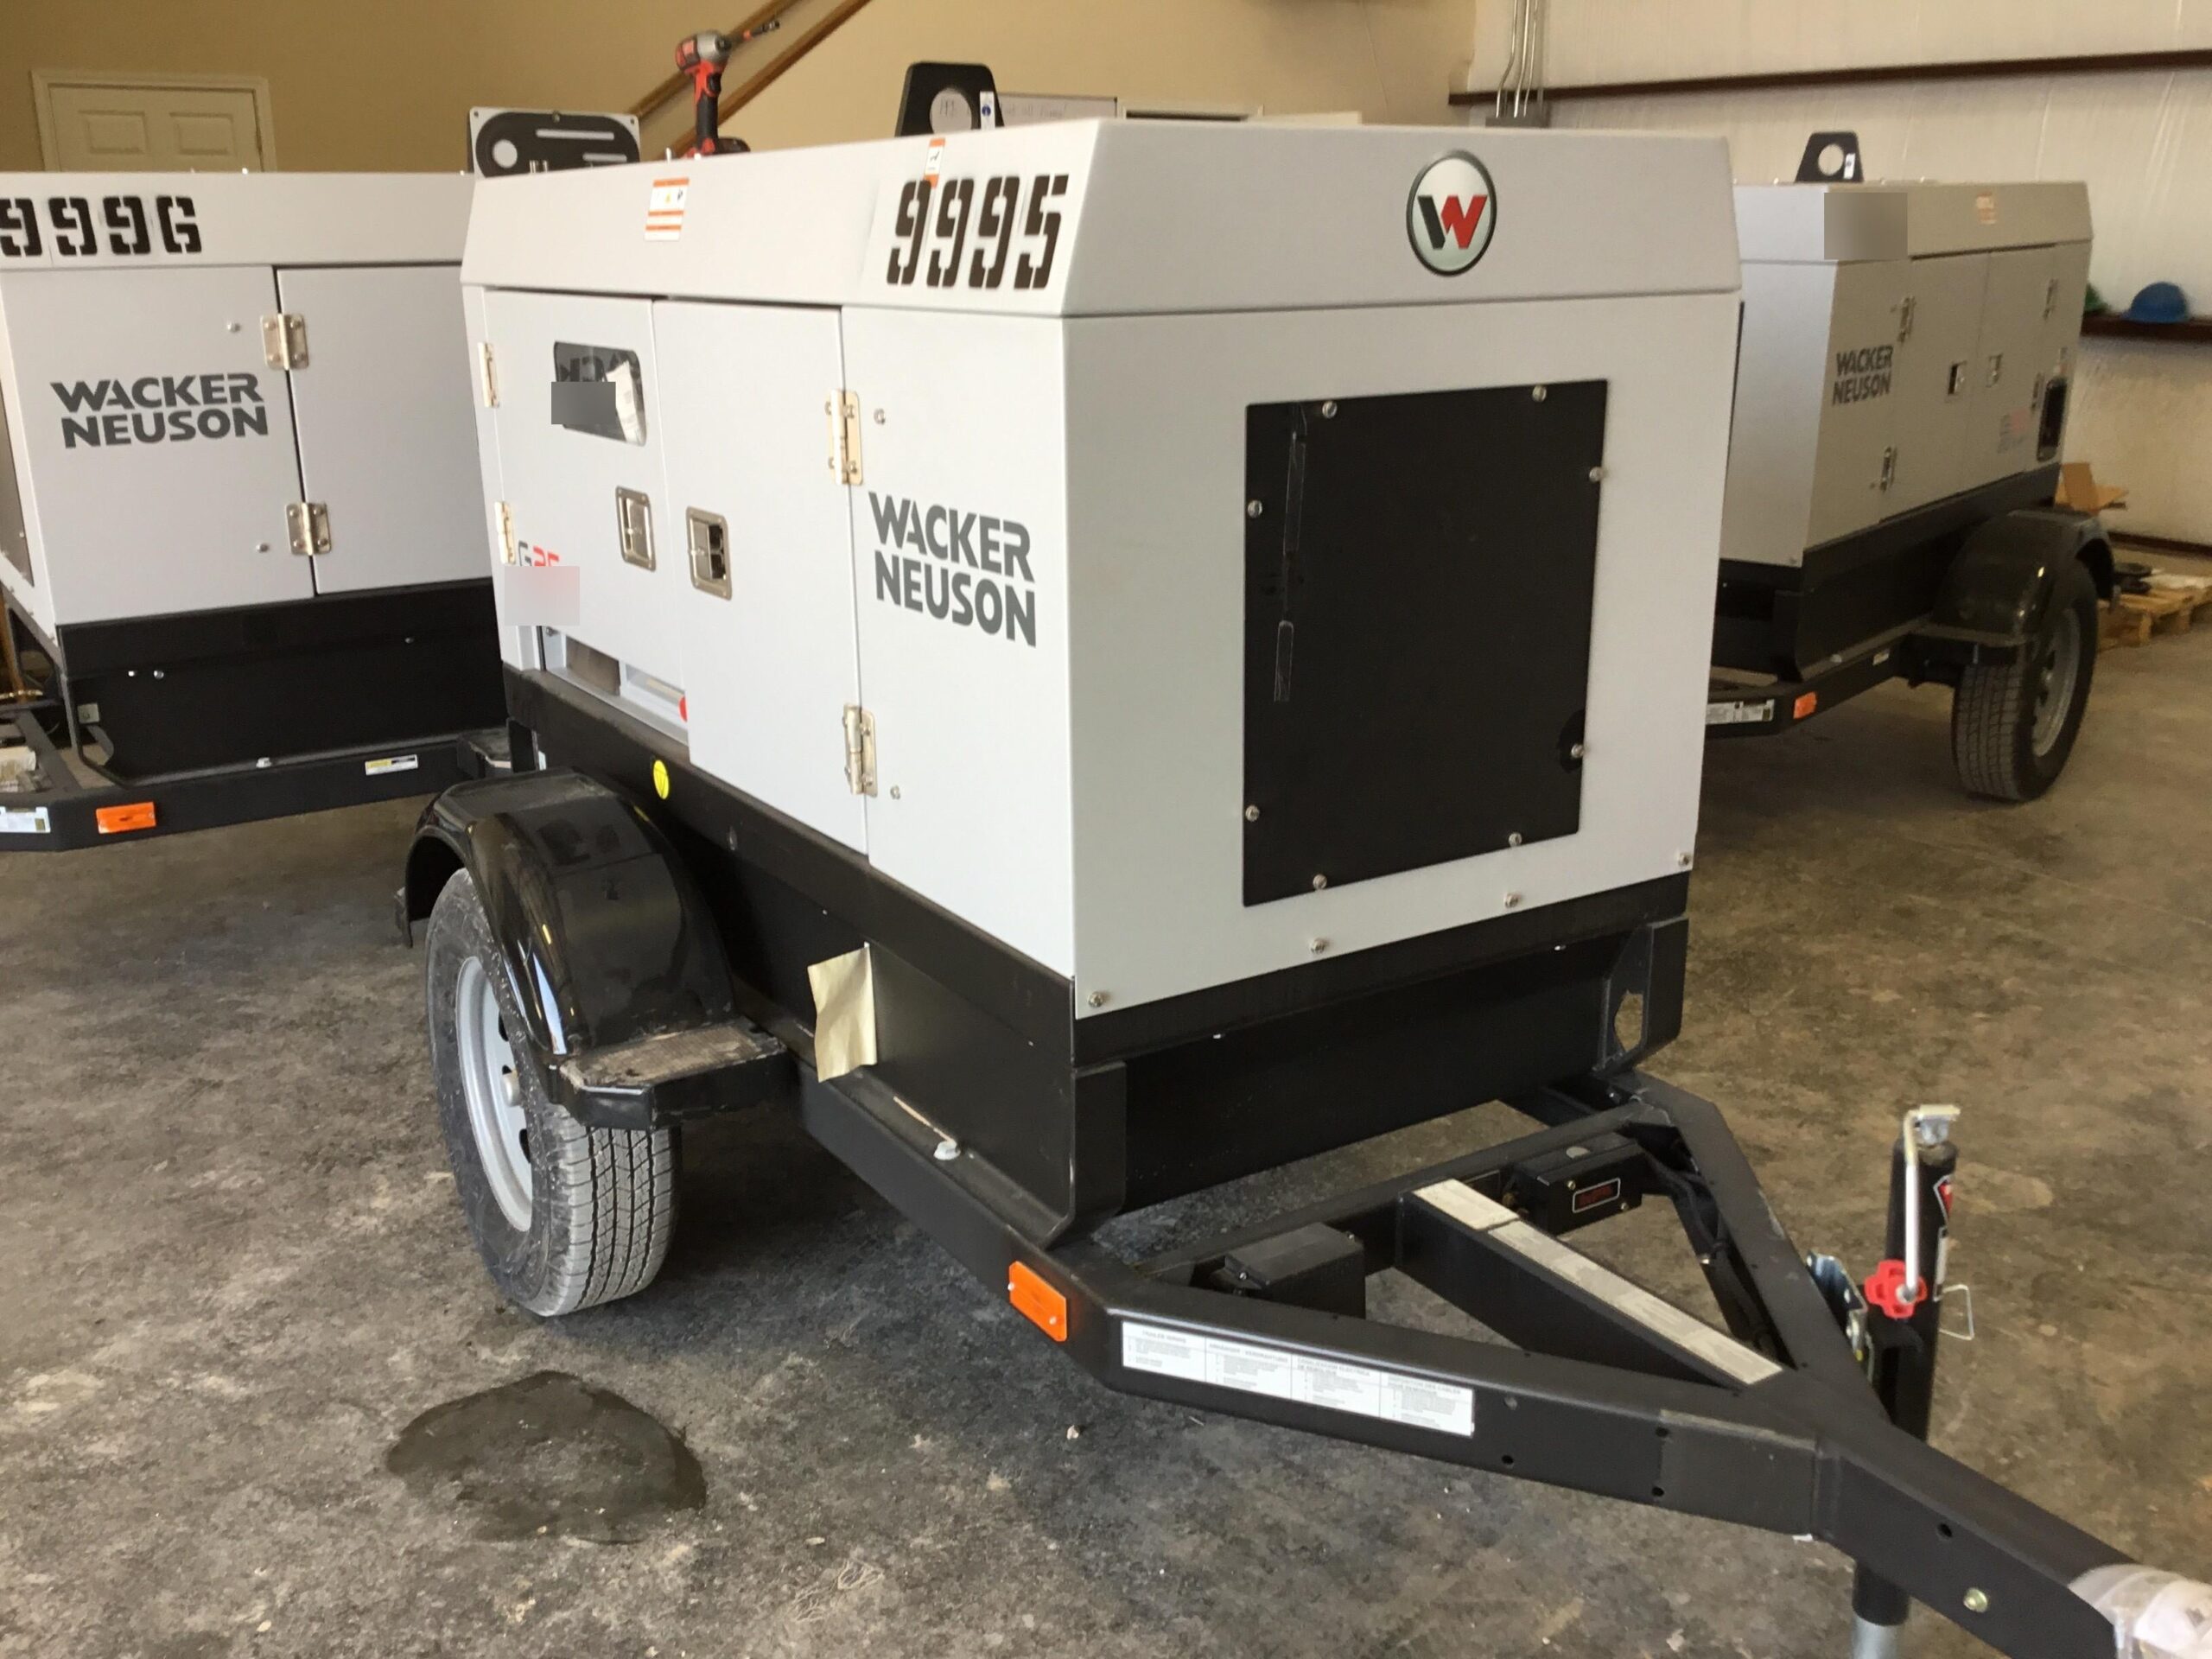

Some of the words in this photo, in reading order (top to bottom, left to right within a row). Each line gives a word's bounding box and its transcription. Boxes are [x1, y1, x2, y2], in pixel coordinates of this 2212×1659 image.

[887, 174, 1069, 289] 9995
[1836, 345, 1893, 377] WACKER
[50, 372, 264, 413] WACKER
[1832, 372, 1892, 405] NEUSON
[61, 405, 269, 448] NEUSON
[868, 491, 1036, 584] WACKER
[874, 550, 1037, 648] NEUSON
